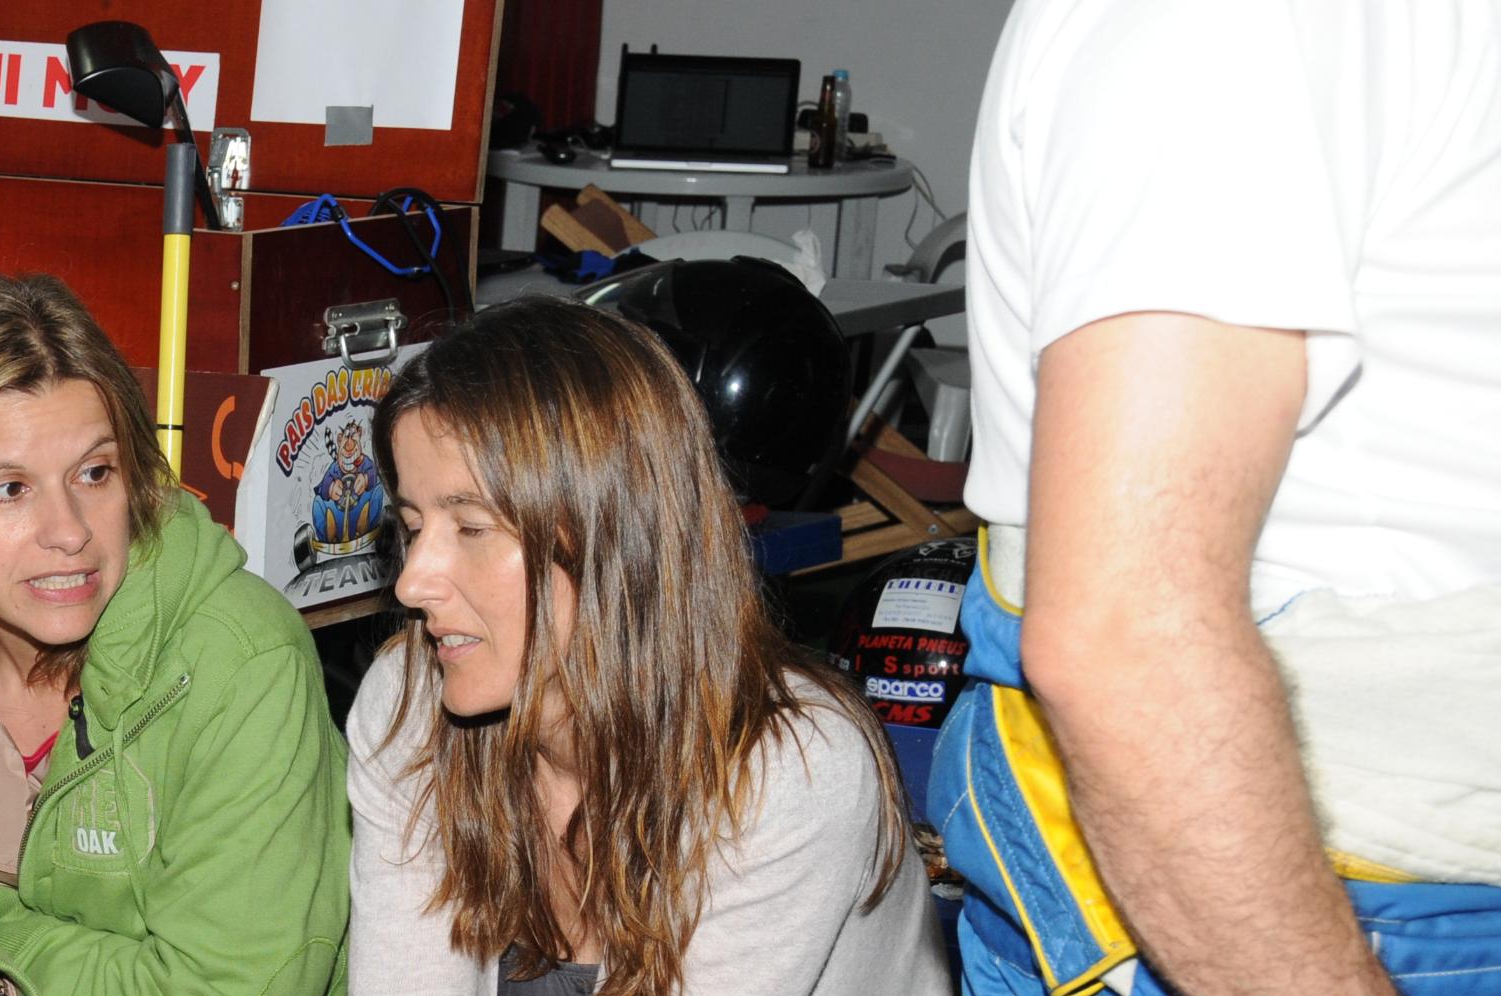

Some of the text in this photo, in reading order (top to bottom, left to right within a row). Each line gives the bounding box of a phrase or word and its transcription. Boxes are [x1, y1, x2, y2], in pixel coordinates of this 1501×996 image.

[43, 55, 206, 120] MY
[276, 397, 314, 477] PAIS
[311, 365, 349, 425] DAS
[858, 635, 965, 655] PLANETA PNEUS
[866, 678, 945, 699] sparco
[76, 827, 119, 855] OAK
